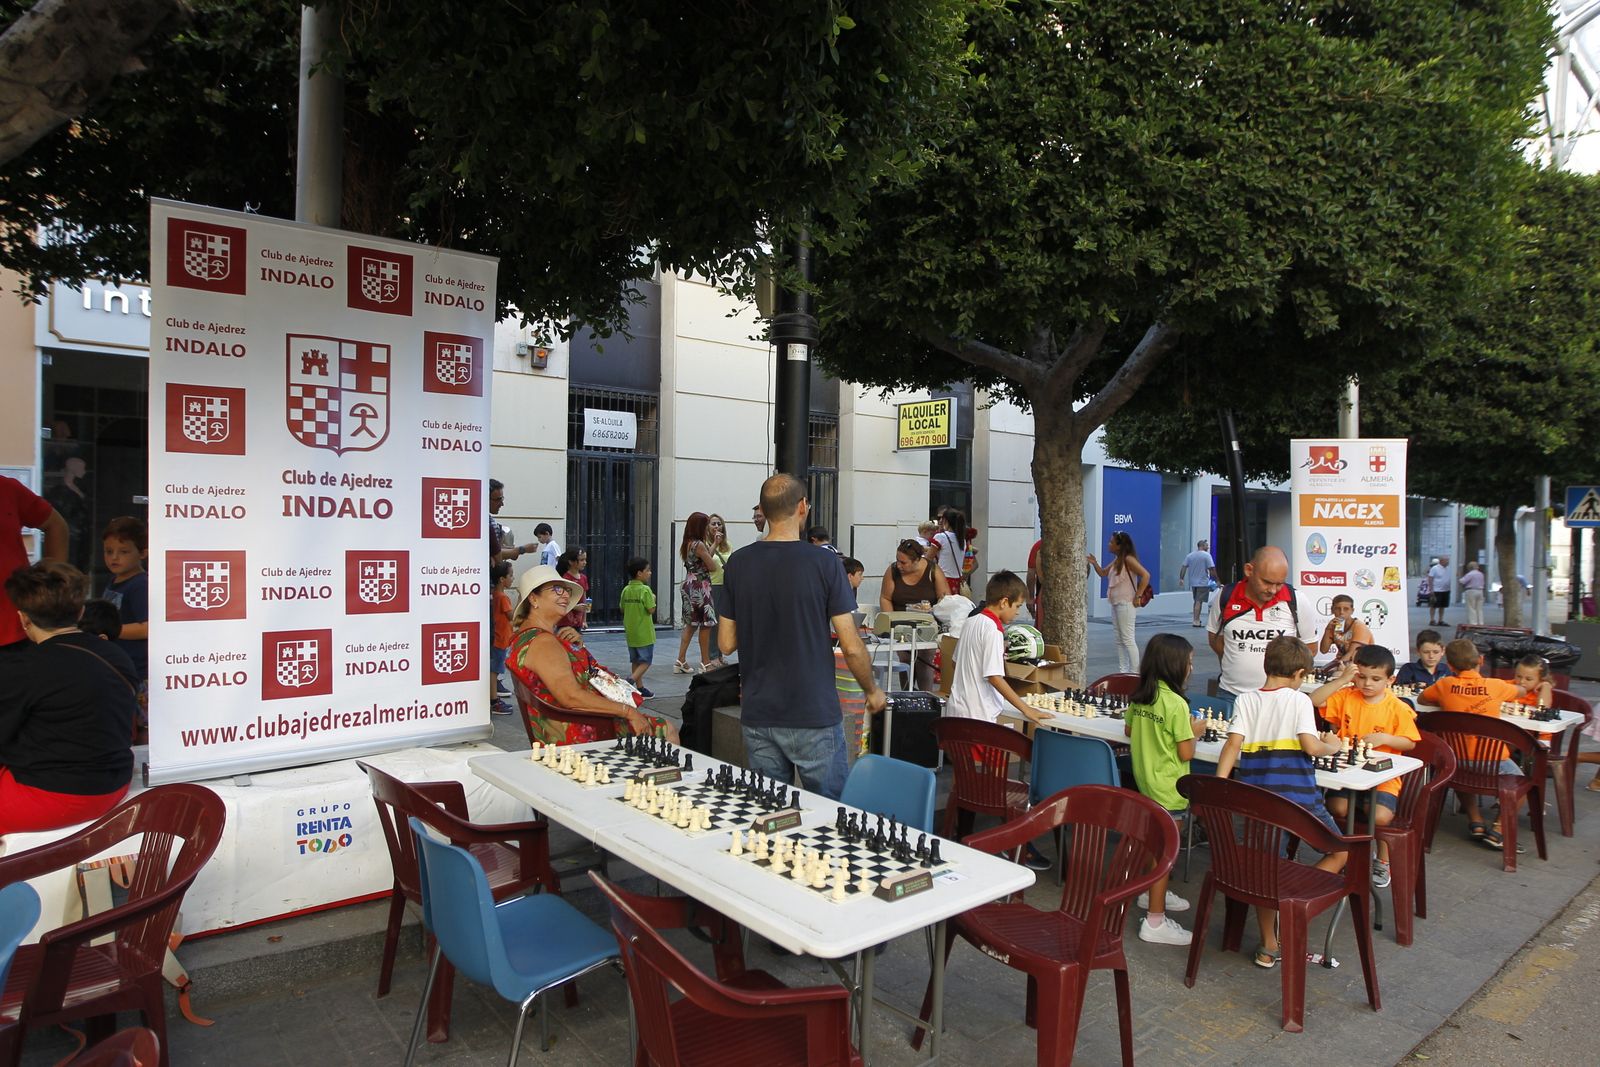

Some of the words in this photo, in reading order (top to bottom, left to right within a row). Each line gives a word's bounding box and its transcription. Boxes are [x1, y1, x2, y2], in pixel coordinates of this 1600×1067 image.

[261, 249, 282, 261] Club
[285, 252, 297, 262] de
[299, 255, 334, 269] Ajedrez
[260, 267, 334, 289] INDALO
[425, 274, 443, 284] Club
[445, 277, 455, 285] de
[457, 279, 486, 292] Ajedrez
[424, 291, 484, 311] INDALO
[166, 317, 190, 329] Club
[192, 320, 205, 331] de
[208, 322, 246, 335] Ajedrez
[165, 337, 246, 358] INDALO
[902, 403, 946, 419] ALQUILER
[422, 420, 440, 429] Club
[442, 421, 452, 430] de
[454, 422, 482, 432] Ajedrez
[909, 418, 941, 430] LOCAL
[422, 437, 482, 453] INDALO
[901, 437, 914, 446] 696
[916, 435, 930, 445] 470
[932, 434, 946, 444] 900
[282, 469, 316, 485] Club
[320, 472, 337, 487] de
[340, 473, 393, 491] Ajedrez
[165, 484, 189, 494] Club
[192, 485, 205, 495] de
[207, 486, 245, 497] Ajedrez
[165, 503, 246, 519] INDALO
[282, 495, 394, 519] INDALO
[1312, 503, 1384, 519] NACEX
[1114, 514, 1133, 524] BBVA
[1334, 539, 1397, 558] integra2
[261, 567, 283, 577] Club
[285, 567, 297, 576] de
[299, 567, 331, 578] Ajedrez
[421, 566, 438, 575] Club
[440, 566, 450, 574] de
[451, 566, 481, 576] Ajedrez
[261, 585, 332, 601] INDALO
[421, 583, 481, 596] INDALO
[345, 644, 364, 653] Club
[367, 642, 377, 652] de
[379, 642, 409, 653] Ajedrez
[165, 653, 189, 664] Club
[192, 653, 205, 663] de
[208, 652, 247, 664] Ajedrez
[345, 658, 410, 676] INDALO
[165, 671, 248, 690] INDALO
[1450, 684, 1489, 696] MIGUEL
[181, 699, 469, 747] www.clubajedrezalmeria.com
[297, 803, 351, 817] GRUPO
[297, 816, 352, 836] RENTA
[297, 833, 353, 855] TODO
